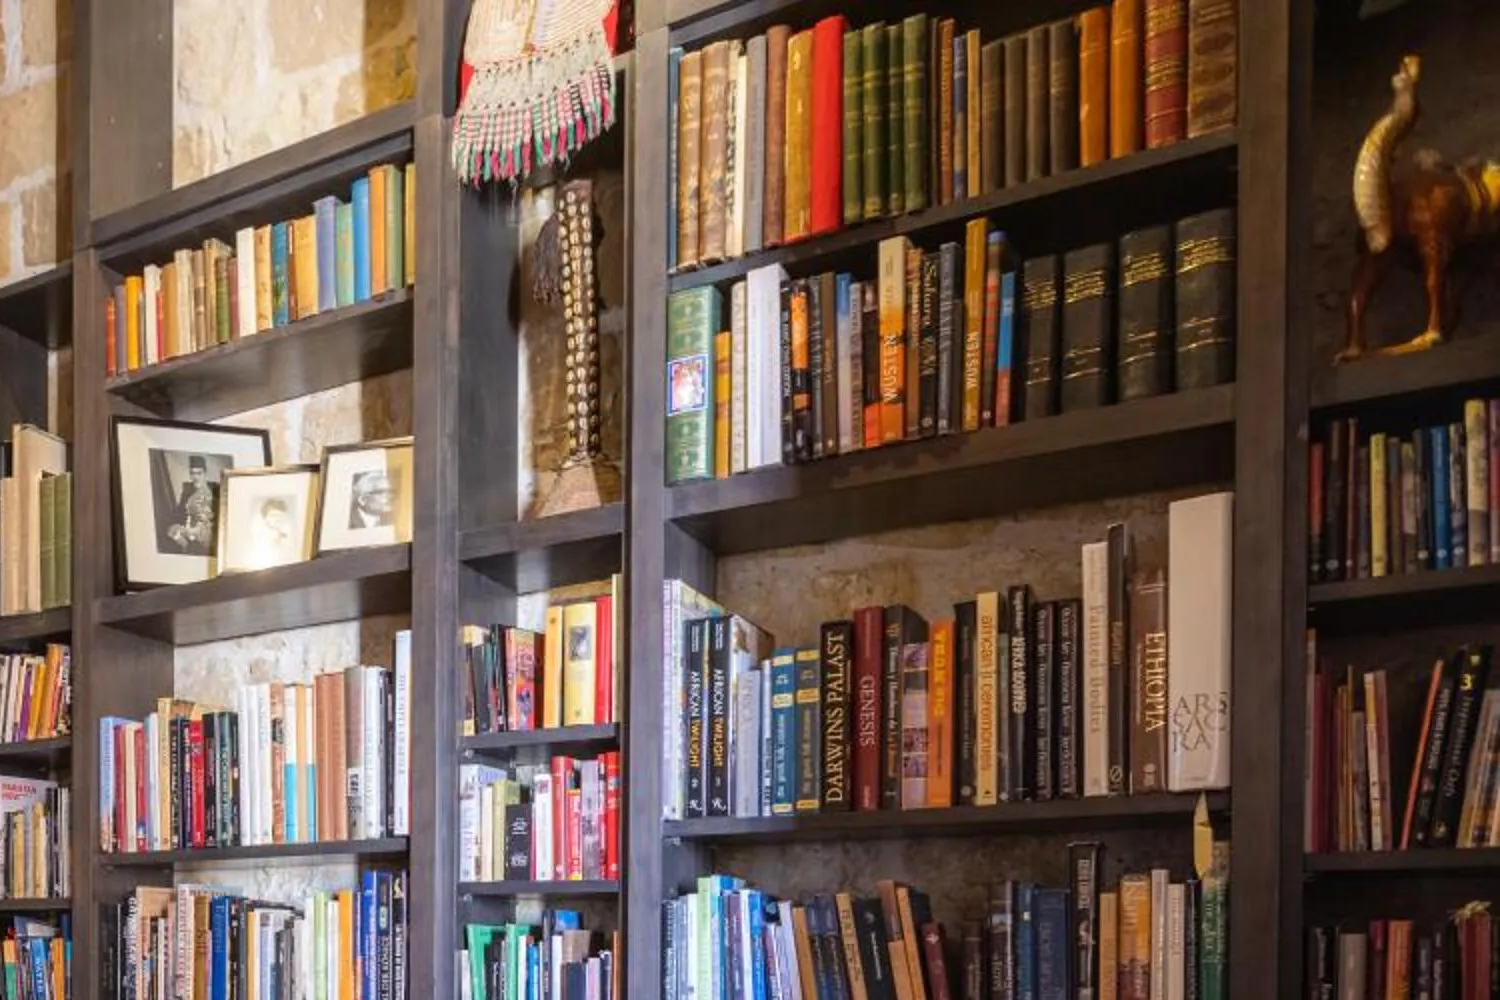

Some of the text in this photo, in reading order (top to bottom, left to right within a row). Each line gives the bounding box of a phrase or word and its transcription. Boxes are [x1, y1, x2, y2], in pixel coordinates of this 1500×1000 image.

[689, 671, 700, 716] AFRICAN
[713, 669, 725, 715] AFRICAN
[860, 676, 875, 747] GENESIS
[981, 615, 994, 771] african ceremonies
[1144, 632, 1166, 733] ETHIOPIA
[689, 718, 700, 768] TWILIGHT
[713, 718, 725, 767] TWILIGHT
[827, 631, 844, 802] DARWINS PALAST
